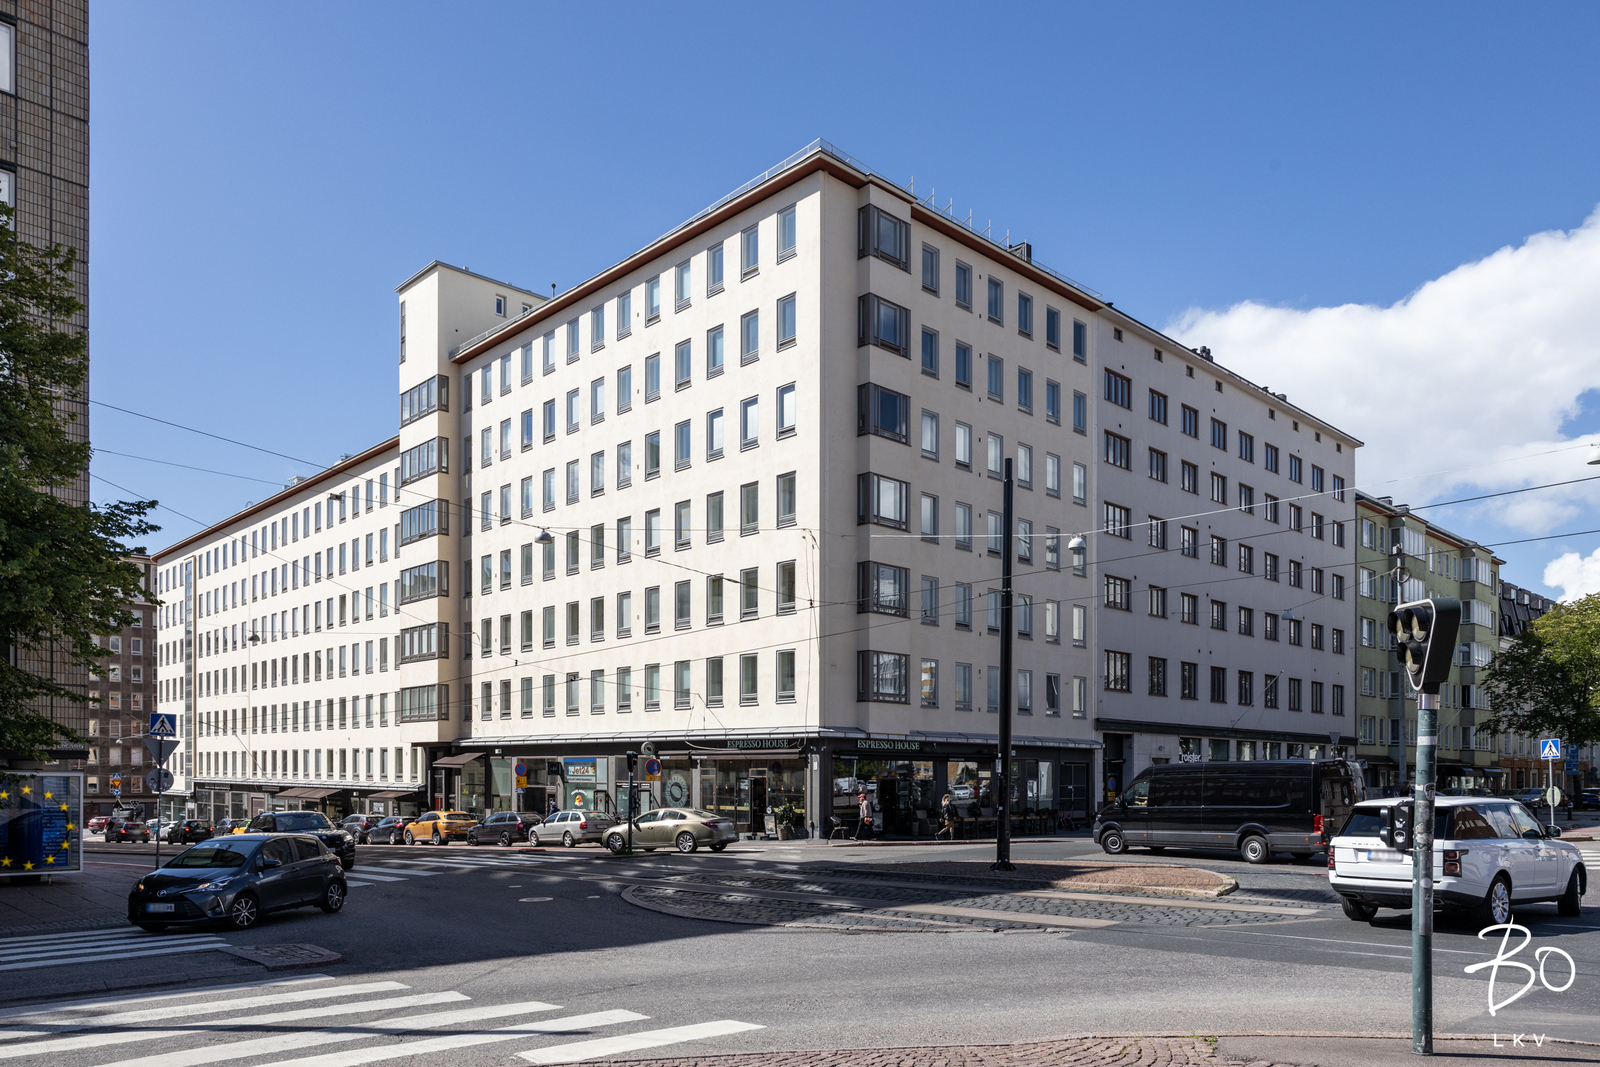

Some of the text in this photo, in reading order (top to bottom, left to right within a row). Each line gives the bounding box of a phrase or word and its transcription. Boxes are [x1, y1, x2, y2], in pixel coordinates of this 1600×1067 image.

[727, 739, 789, 749] ESPRESSO HOUSE
[857, 739, 921, 751] ESPRESSO HOUSE
[571, 766, 590, 775] Jet24
